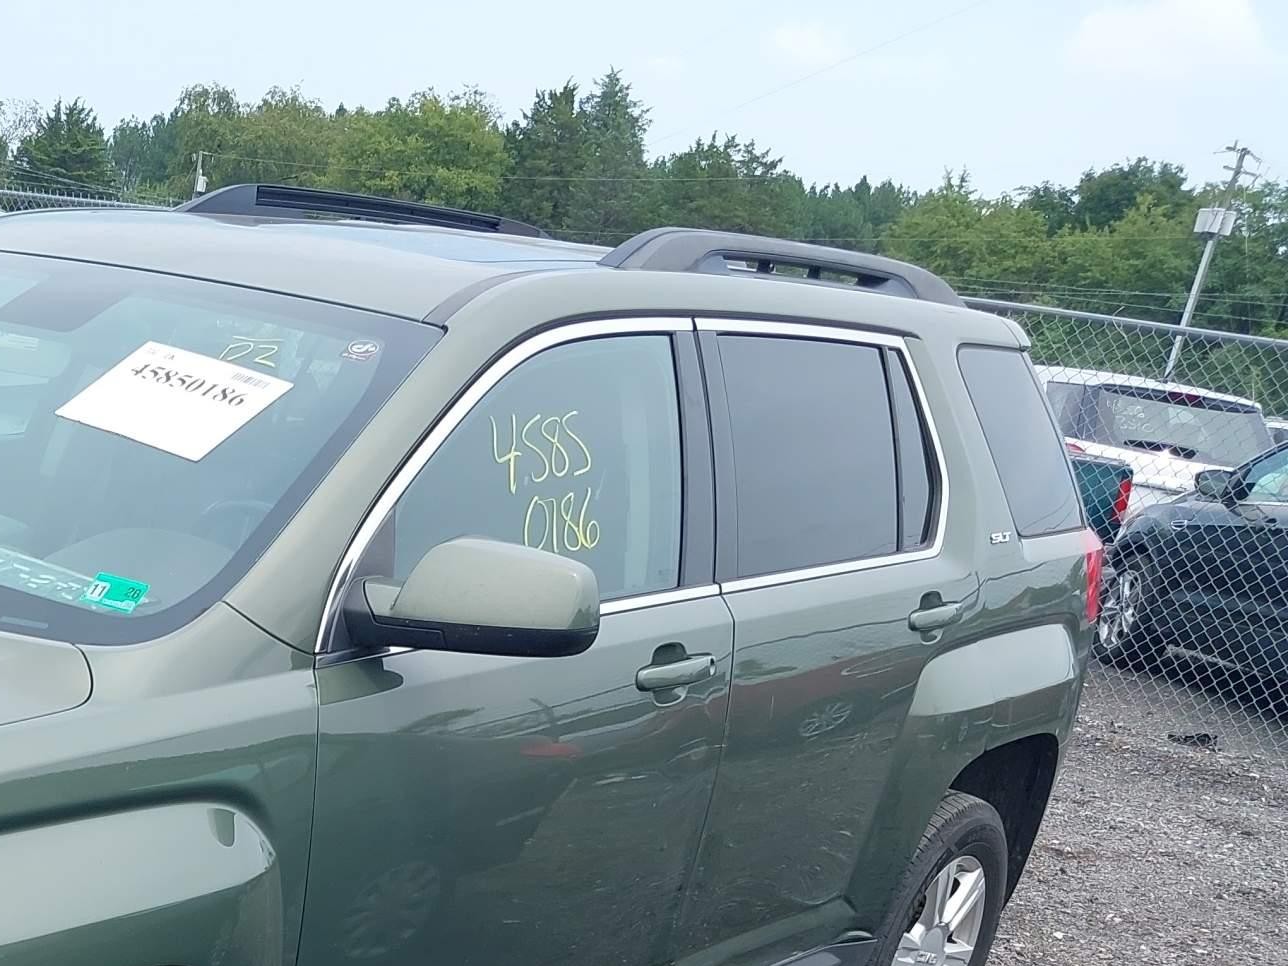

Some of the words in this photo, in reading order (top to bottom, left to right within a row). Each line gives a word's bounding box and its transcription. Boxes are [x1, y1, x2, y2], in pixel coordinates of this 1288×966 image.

[130, 362, 249, 407] 45850186
[490, 410, 592, 495] 4585
[990, 531, 1012, 544] SLT
[90, 582, 108, 598] 11
